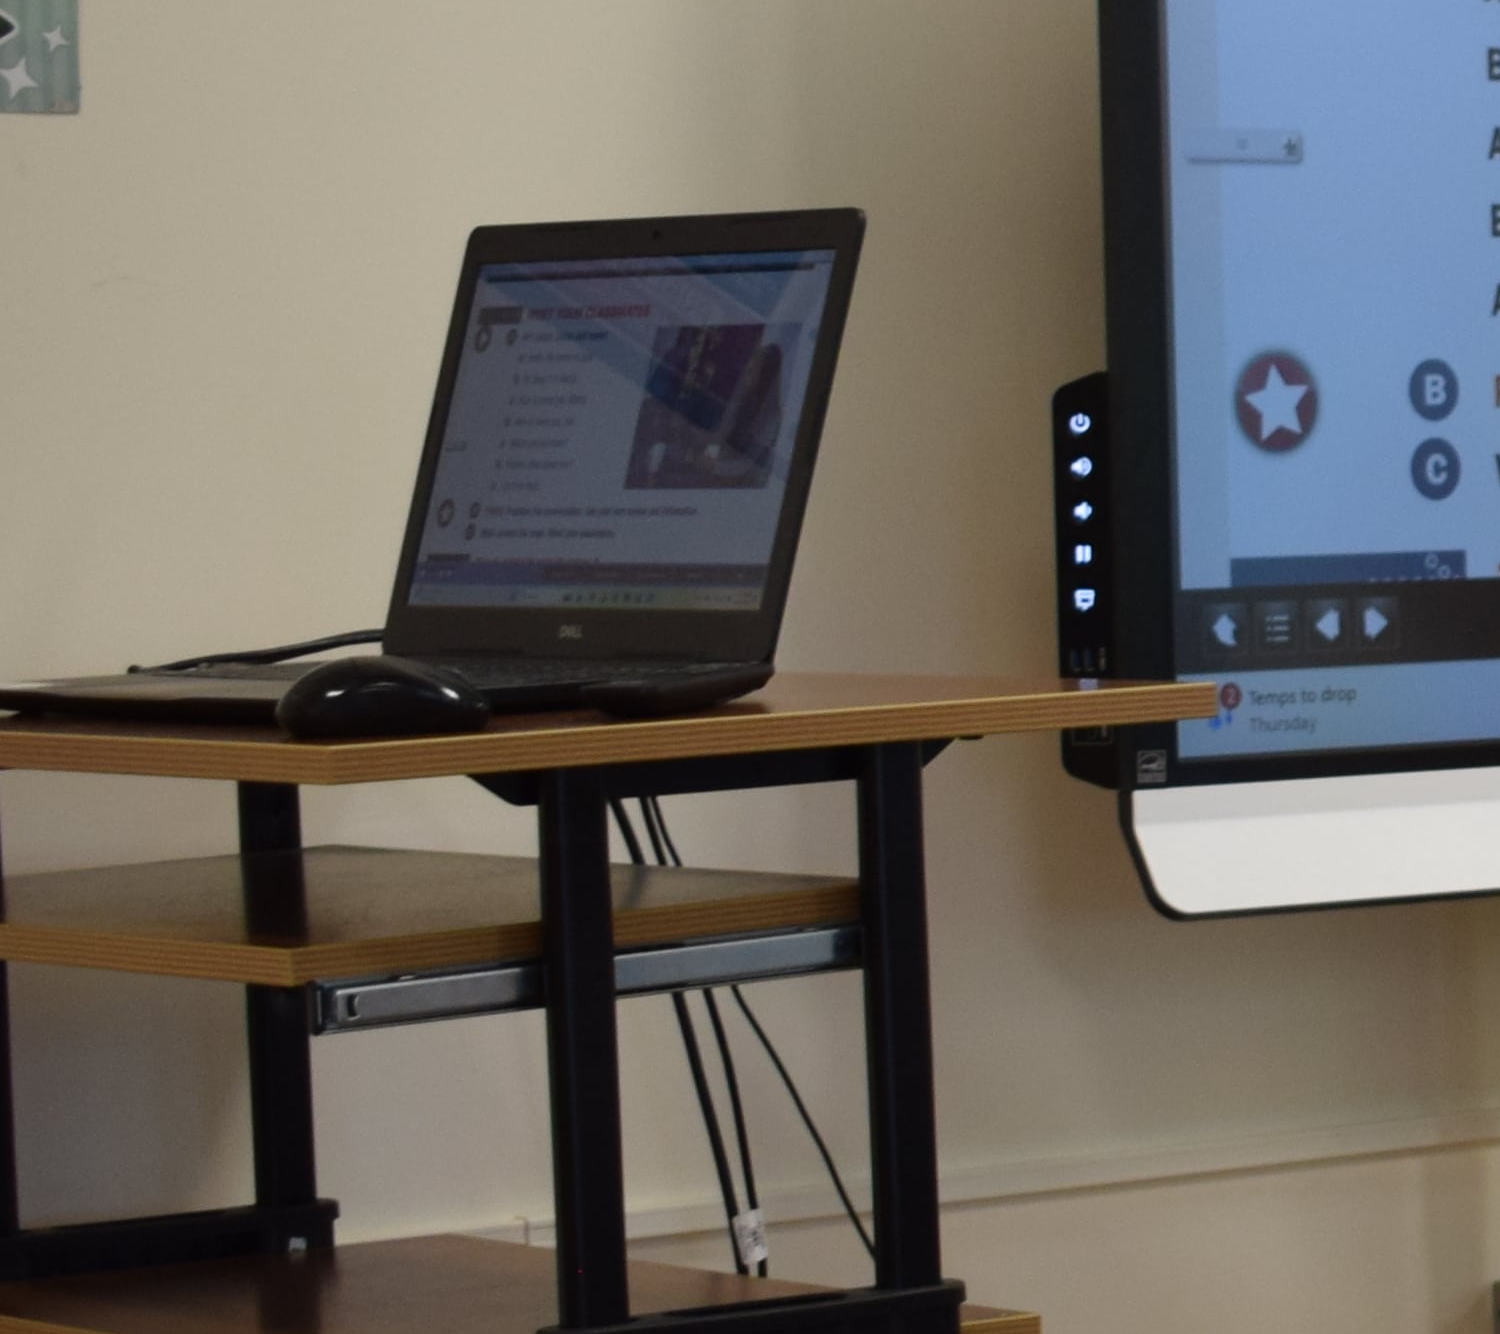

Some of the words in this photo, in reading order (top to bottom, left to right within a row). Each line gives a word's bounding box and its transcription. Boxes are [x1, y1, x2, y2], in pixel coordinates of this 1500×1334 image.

[1249, 689, 1297, 708] Temps
[1301, 687, 1316, 703] to
[1321, 685, 1358, 706] drop
[1249, 715, 1319, 734] Thursday
